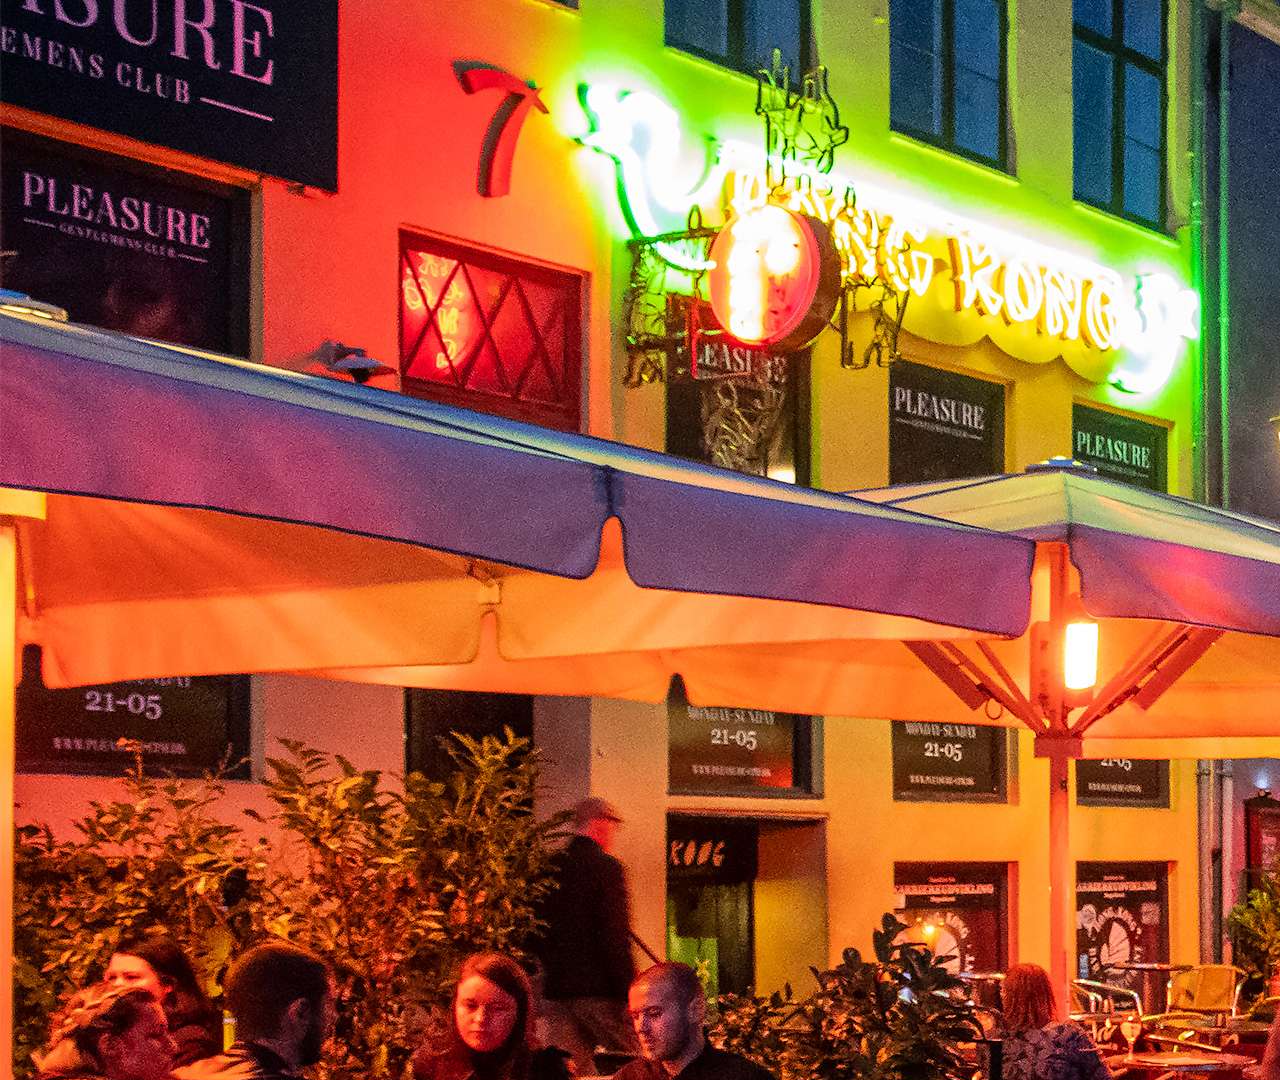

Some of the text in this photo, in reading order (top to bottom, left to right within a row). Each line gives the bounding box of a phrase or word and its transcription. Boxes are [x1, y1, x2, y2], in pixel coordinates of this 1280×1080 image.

[116, 62, 190, 104] CLUB
[453, 60, 549, 198] 7
[24, 171, 211, 250] PLEASURE
[957, 234, 1123, 350] KONG
[895, 387, 985, 430] PLEASURE
[1077, 431, 1151, 469] PLEASURE
[85, 690, 163, 720] 21-05
[711, 728, 758, 751] 21-05
[924, 742, 963, 761] 21-05
